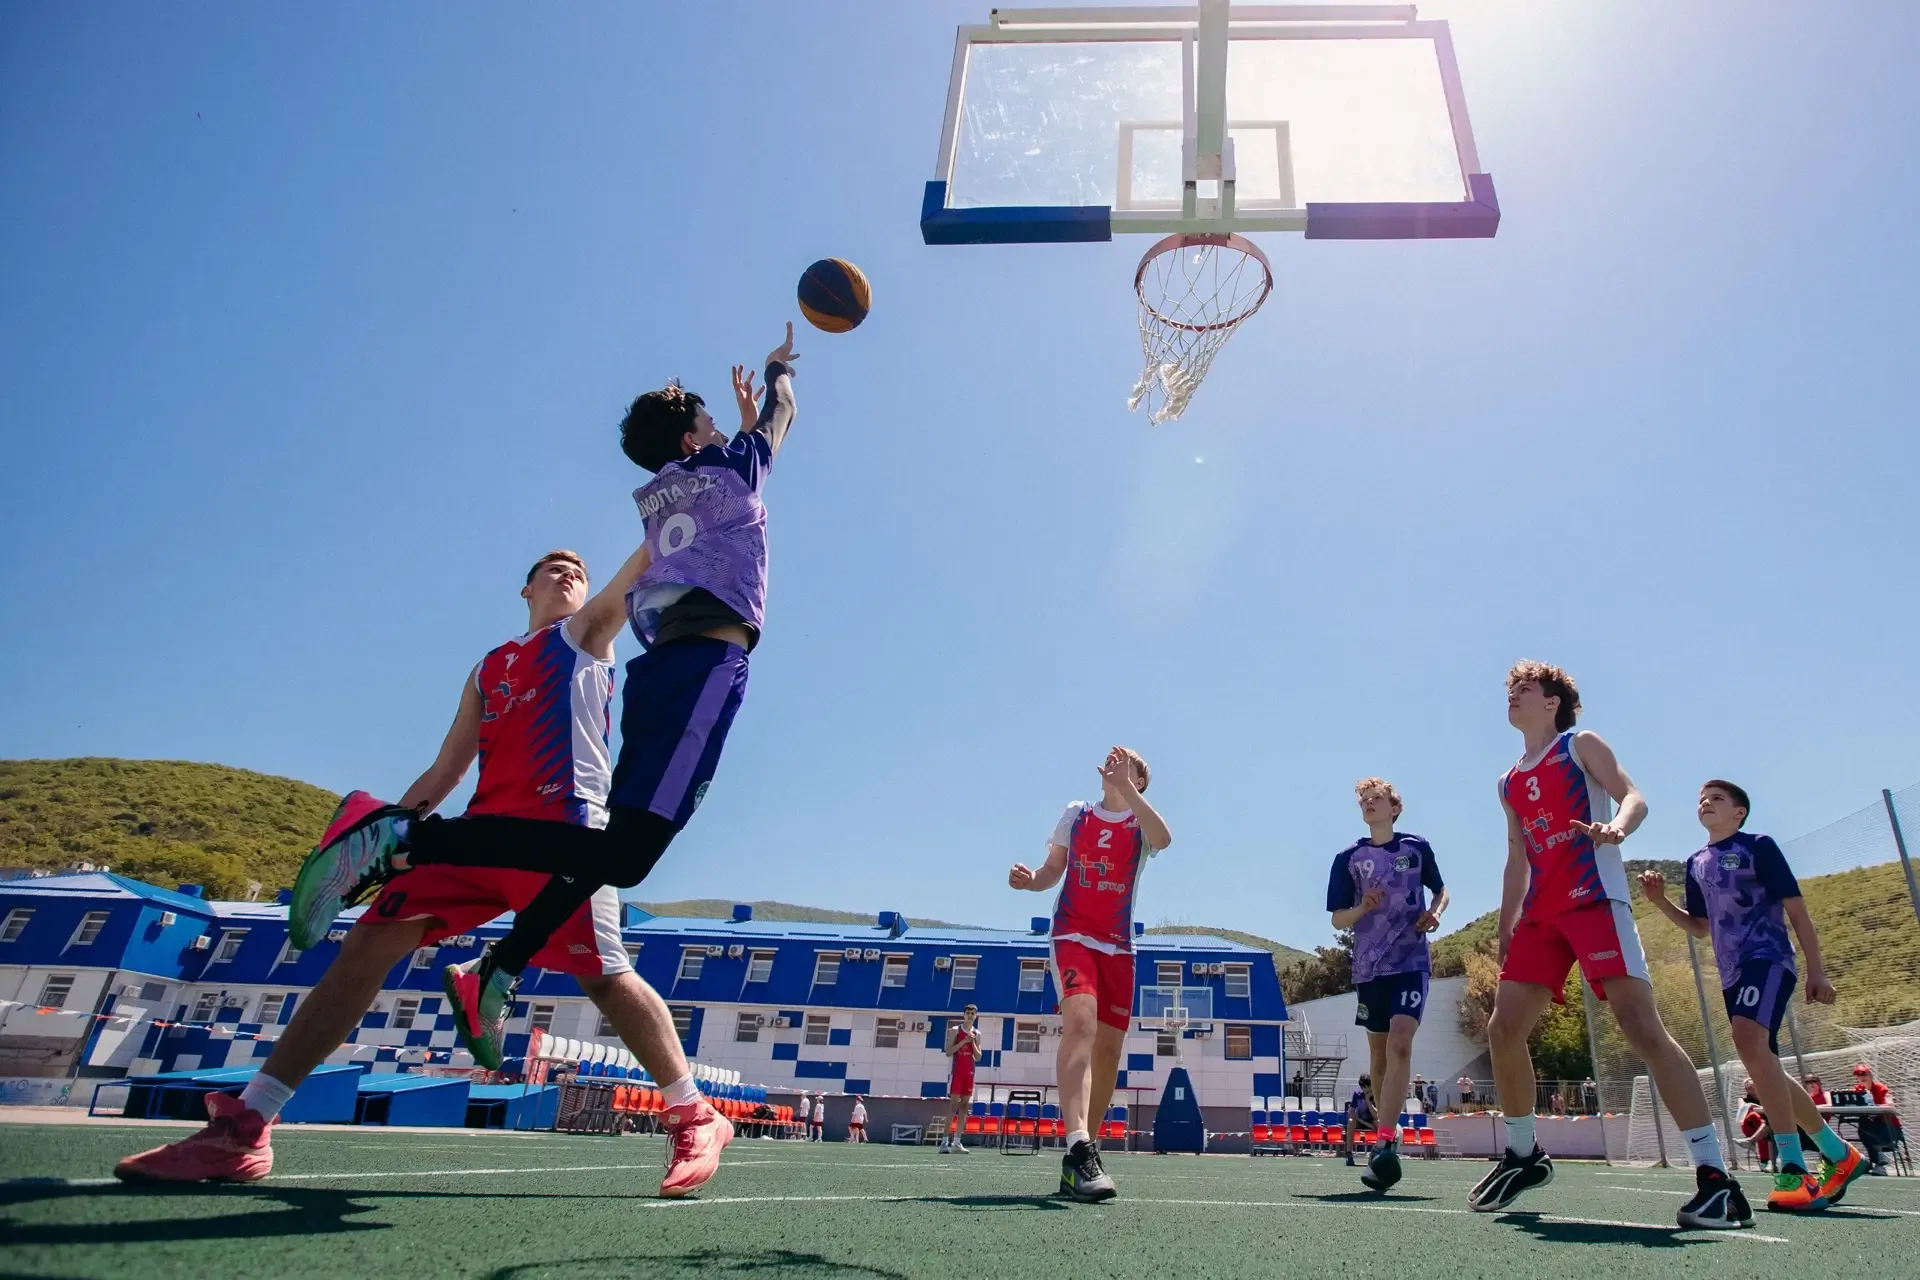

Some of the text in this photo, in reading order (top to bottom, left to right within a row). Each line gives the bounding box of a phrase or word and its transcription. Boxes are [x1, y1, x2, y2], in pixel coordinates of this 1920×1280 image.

[688, 474, 716, 494] 22
[659, 513, 697, 557] 0
[1526, 776, 1541, 801] 3
[1098, 829, 1112, 848] 2
[1063, 969, 1079, 989] 2
[1400, 990, 1421, 1008] 19
[1736, 986, 1760, 1007] 10
